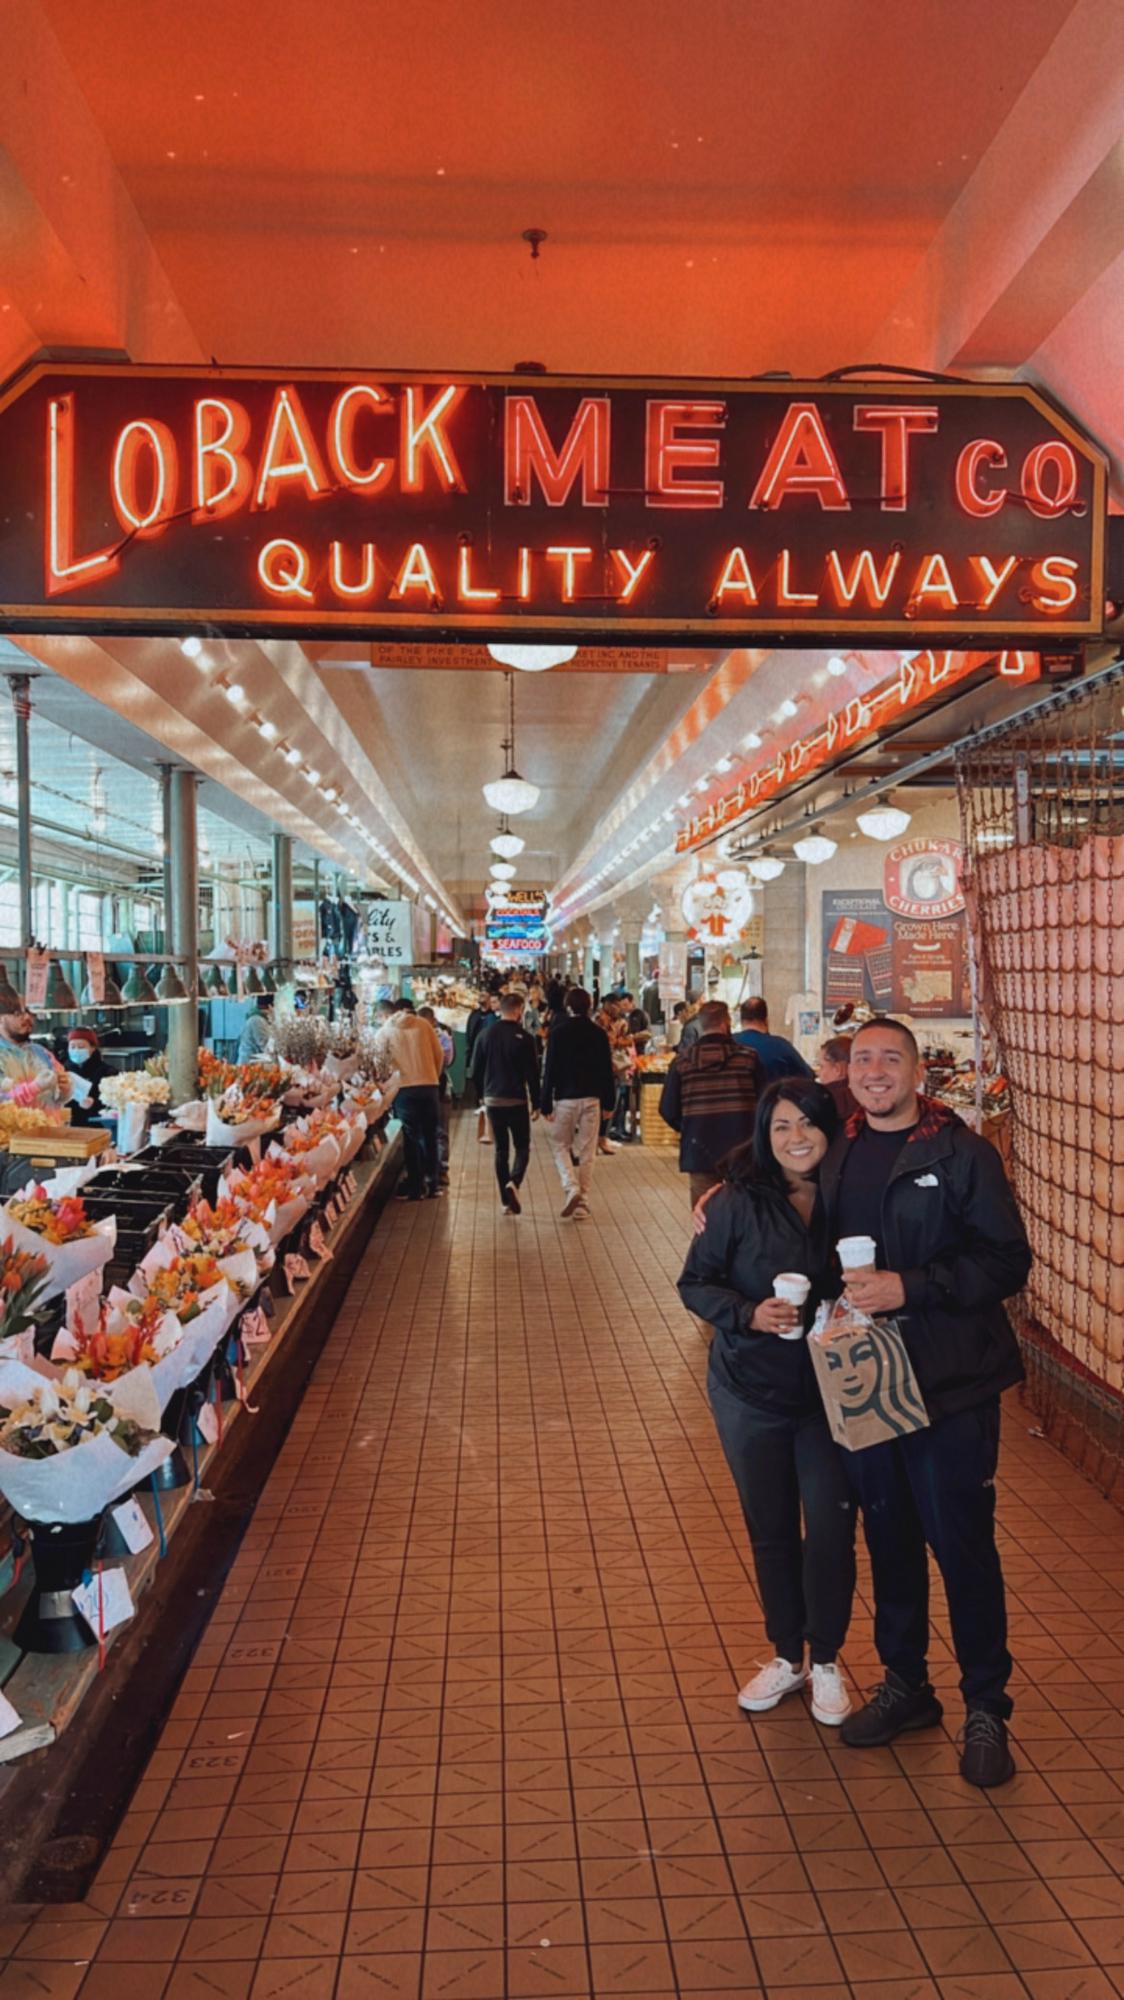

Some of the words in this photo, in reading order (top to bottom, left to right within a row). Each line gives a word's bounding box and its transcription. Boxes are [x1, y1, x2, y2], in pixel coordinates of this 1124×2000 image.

[45, 384, 469, 598] LOBACK
[503, 395, 939, 512] MEAT
[257, 538, 656, 604] QUALITY
[713, 546, 1080, 615] ALWAYS
[498, 939, 542, 950] SEAFOOD
[190, 1756, 240, 1768] 323
